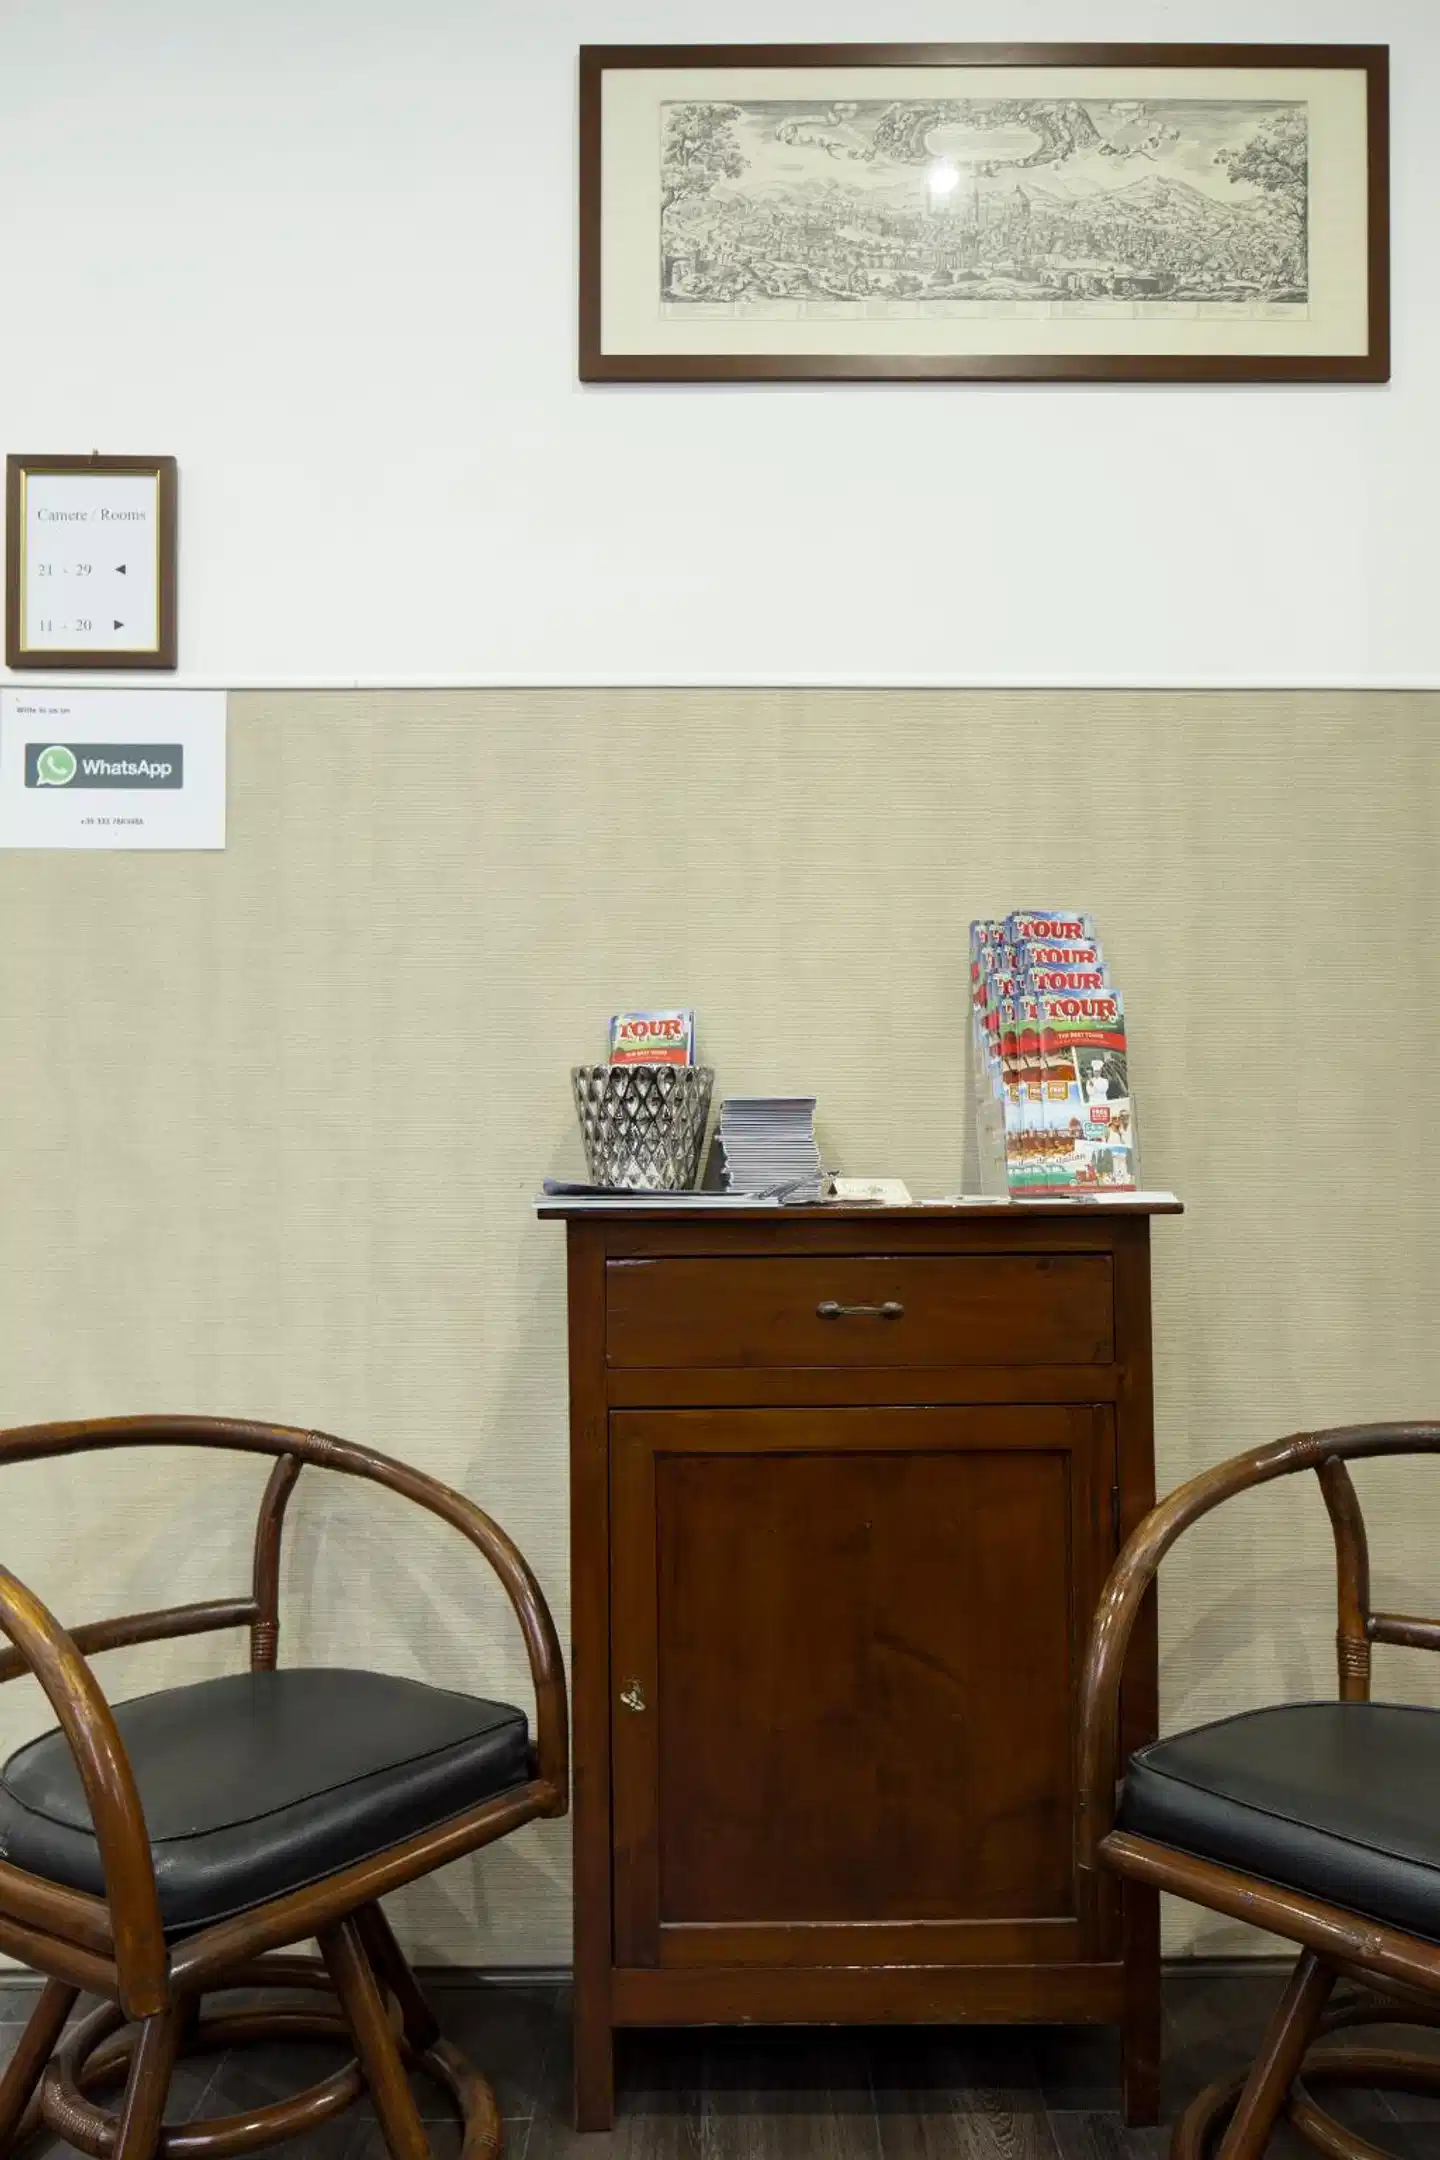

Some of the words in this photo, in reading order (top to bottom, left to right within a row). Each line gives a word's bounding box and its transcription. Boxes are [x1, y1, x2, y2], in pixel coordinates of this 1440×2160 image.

[37, 508, 88, 521] Camere
[100, 508, 146, 521] Rooms
[37, 563, 52, 576] 21
[75, 563, 92, 576] 29
[39, 619, 53, 631] 11
[75, 619, 92, 631] 20
[82, 758, 173, 779] WhatsApp
[1016, 919, 1083, 940] TOUR
[1031, 948, 1096, 963] TOUR
[1032, 971, 1102, 990] TOUR
[1044, 997, 1117, 1018] TOUR
[620, 1019, 683, 1038] TOUR
